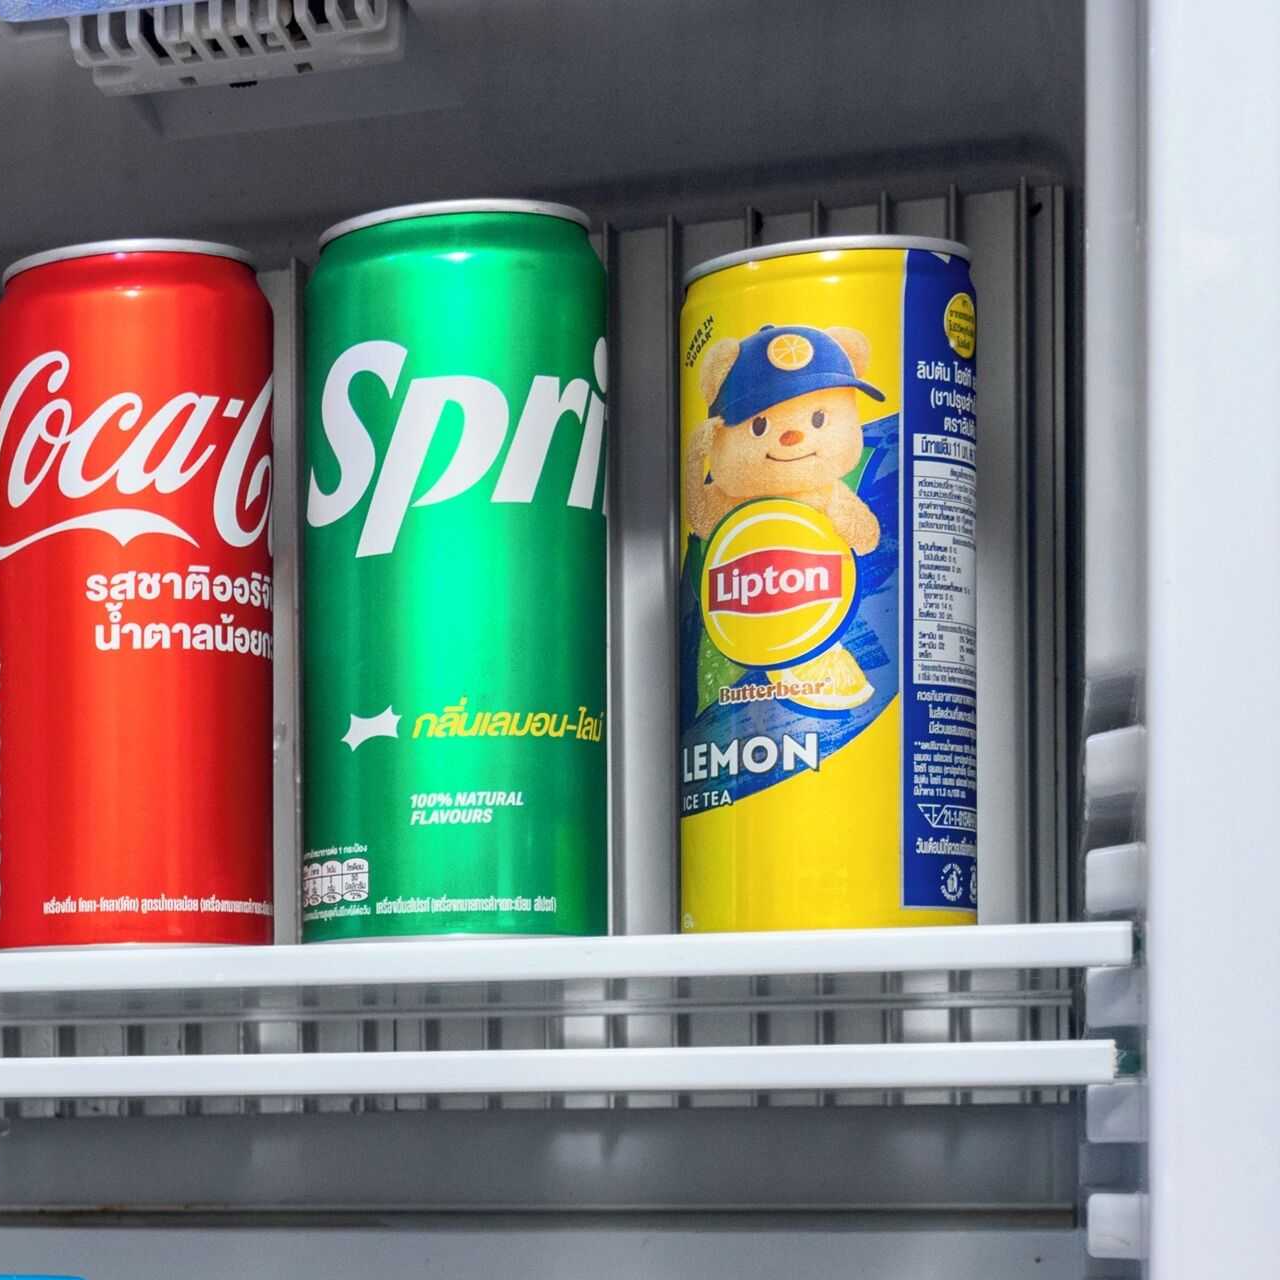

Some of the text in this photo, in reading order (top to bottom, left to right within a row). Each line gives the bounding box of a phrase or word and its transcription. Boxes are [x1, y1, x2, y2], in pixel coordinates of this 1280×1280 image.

[703, 314, 714, 331] IN
[307, 336, 608, 558] Spri
[716, 565, 829, 606] Lipton
[719, 679, 825, 705] Butterbear
[683, 731, 818, 783] LEMON
[410, 791, 524, 809] 100% NATURAL
[683, 789, 732, 812] ICE TEA
[410, 808, 493, 826] FLAVOURS
